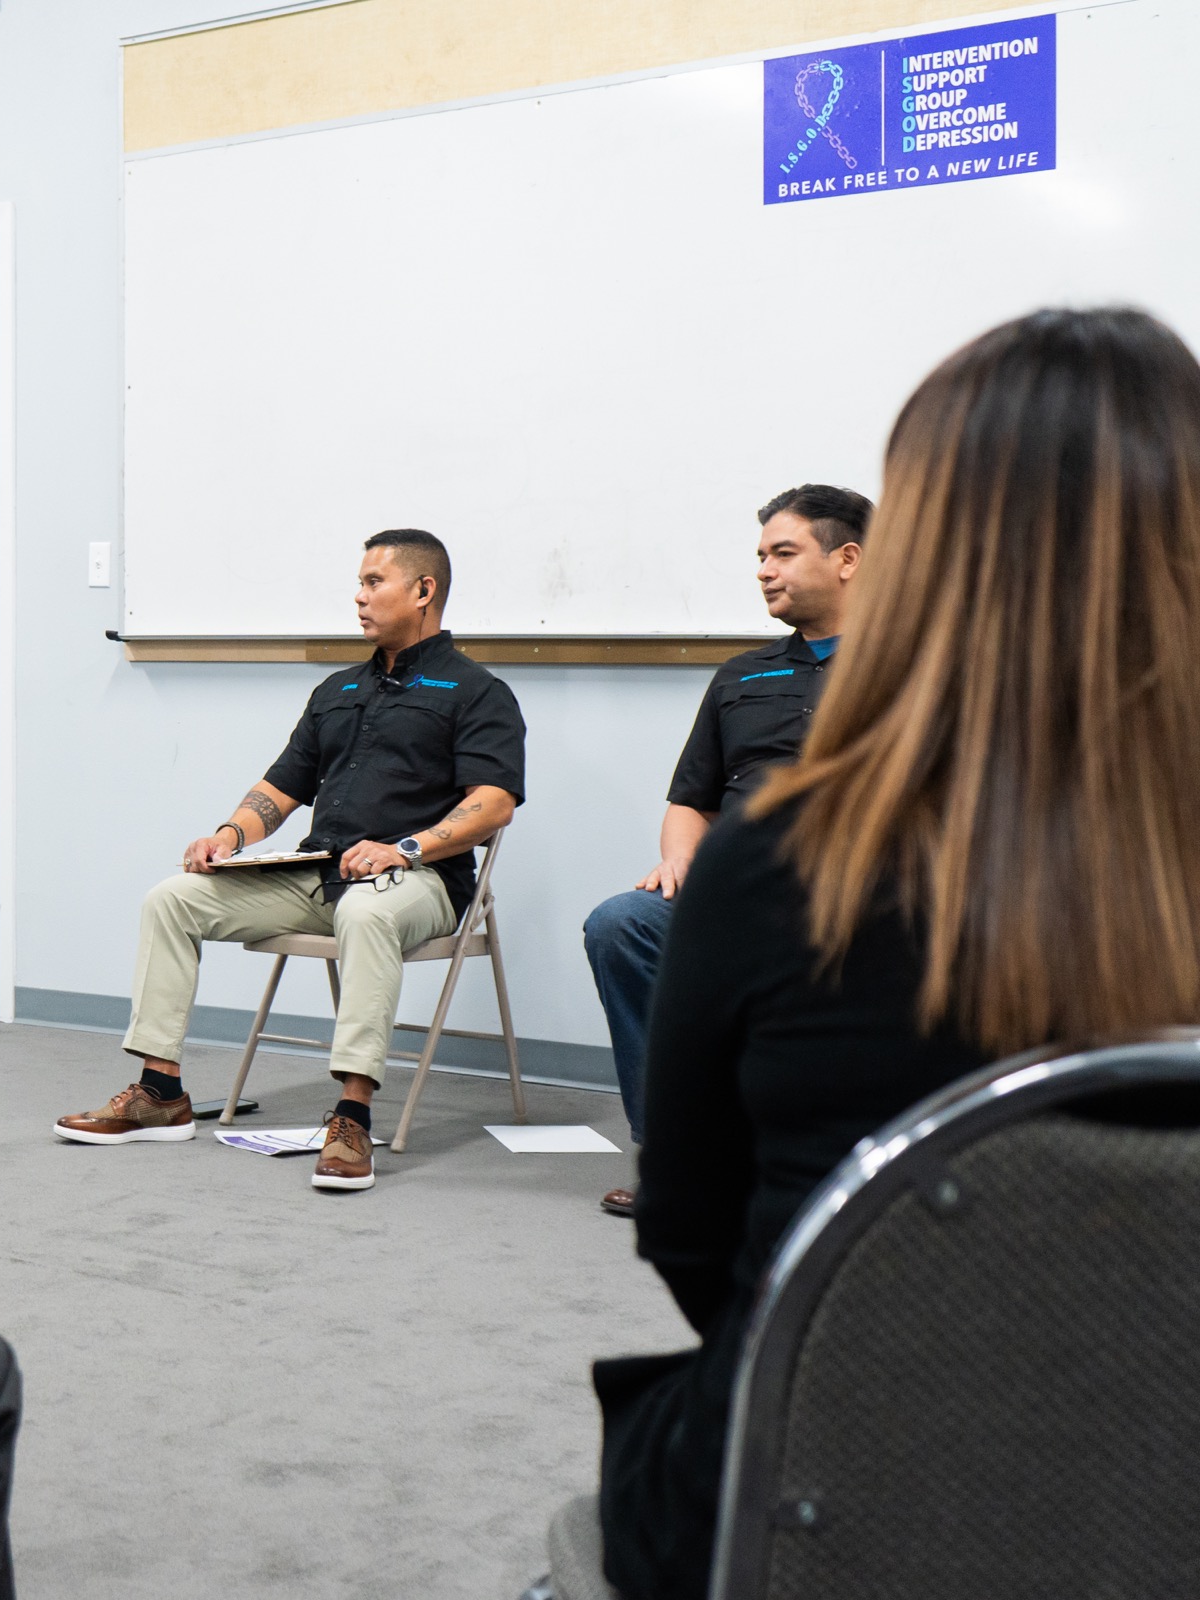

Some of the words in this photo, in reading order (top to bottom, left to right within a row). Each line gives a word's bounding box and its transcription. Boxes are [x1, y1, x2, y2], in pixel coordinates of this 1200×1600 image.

[902, 36, 1038, 74] INTERVENTION
[902, 65, 987, 94] SUPPORT
[902, 88, 968, 113] GROUP
[902, 102, 1007, 133] OVERCOME
[902, 121, 1018, 153] DEPRESSION
[778, 177, 836, 198] BREAK
[843, 170, 888, 190] FREE
[894, 166, 920, 183] TO
[926, 164, 940, 180] A
[946, 157, 991, 177] NEW
[997, 151, 1039, 171] LIFE
